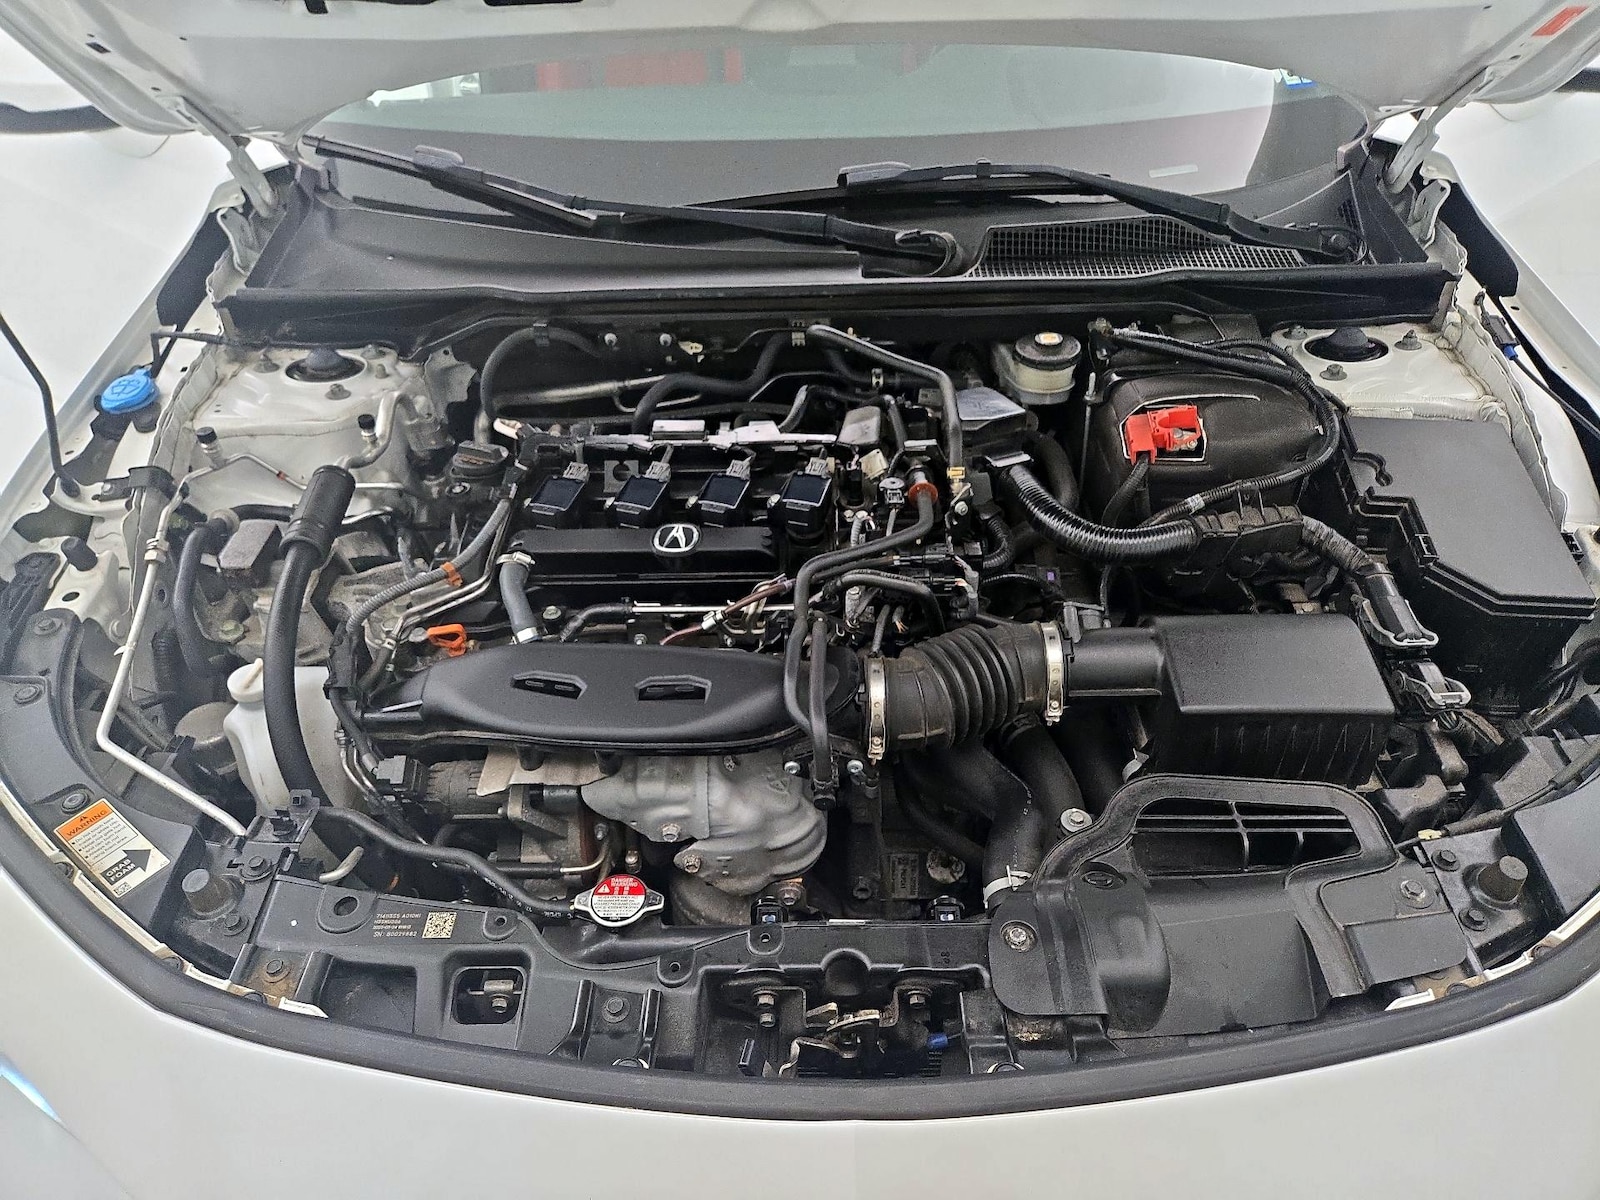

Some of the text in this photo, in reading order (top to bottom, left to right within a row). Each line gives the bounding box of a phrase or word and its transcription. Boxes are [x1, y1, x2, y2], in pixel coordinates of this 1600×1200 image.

[66, 809, 107, 837] WARNING
[105, 858, 131, 877] GRAB
[109, 863, 136, 882] FOAM
